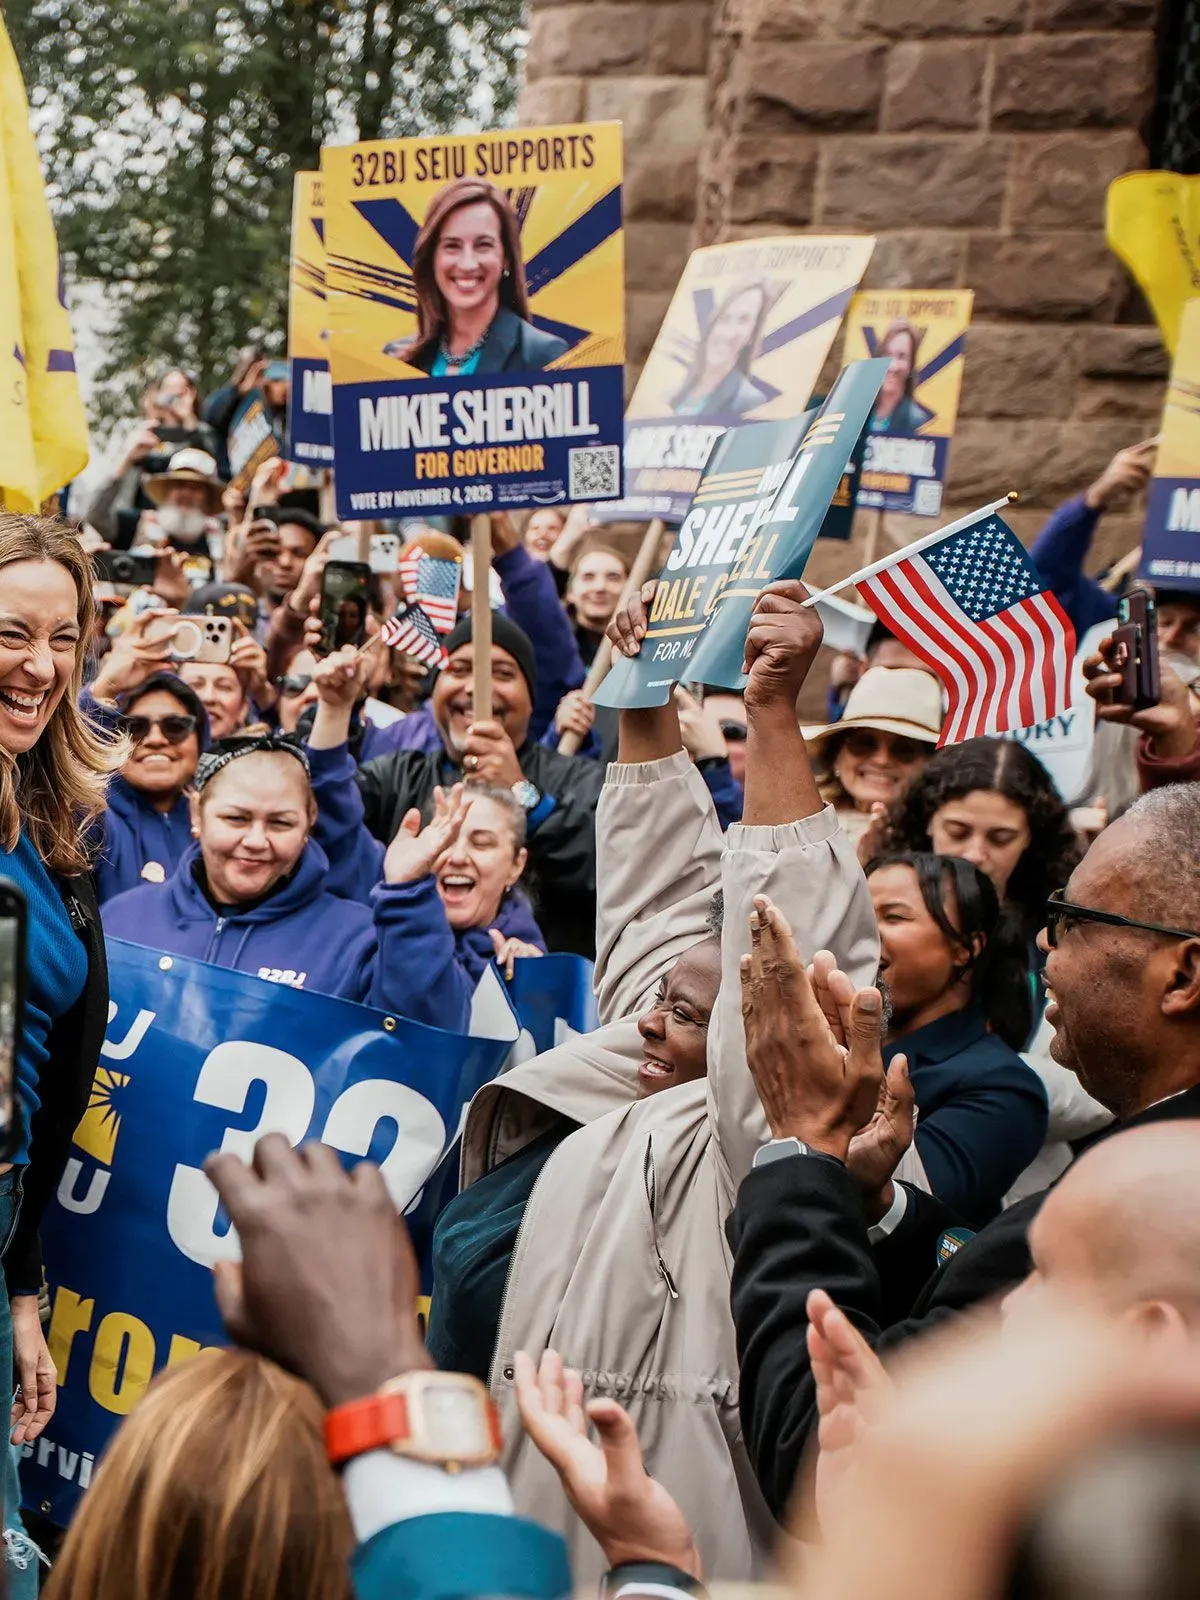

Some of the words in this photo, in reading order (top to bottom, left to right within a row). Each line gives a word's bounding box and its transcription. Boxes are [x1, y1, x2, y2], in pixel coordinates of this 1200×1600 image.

[352, 151, 406, 187] 32BJ
[415, 144, 466, 181] SEIU
[475, 134, 595, 177] SUPPORTS
[358, 391, 451, 452] MIKIE
[452, 380, 599, 446] SHERRILL
[415, 452, 450, 480] FOR
[453, 444, 545, 478] GOVERNOR
[350, 492, 378, 511] VOTE
[378, 490, 394, 509] BY
[394, 487, 452, 507] NOVEMBER
[464, 484, 494, 504] 2025
[649, 575, 708, 622] DALE
[652, 641, 682, 662] FOR
